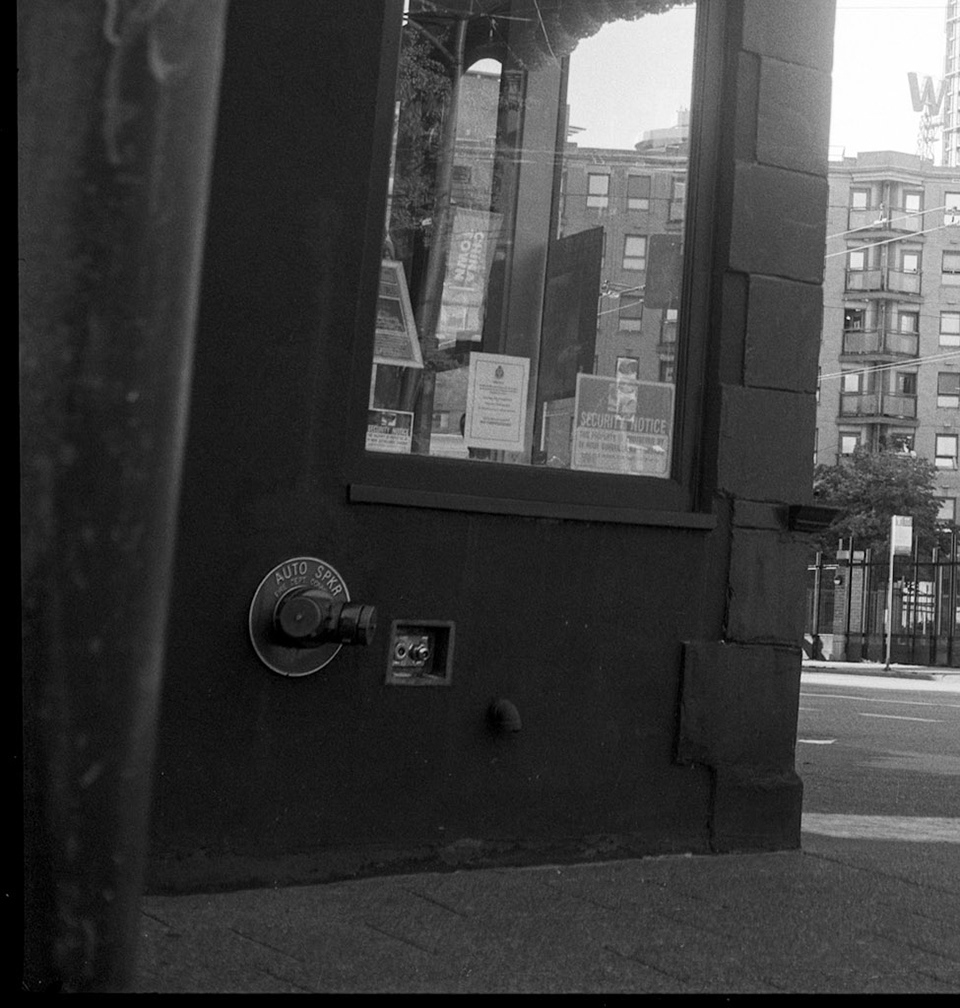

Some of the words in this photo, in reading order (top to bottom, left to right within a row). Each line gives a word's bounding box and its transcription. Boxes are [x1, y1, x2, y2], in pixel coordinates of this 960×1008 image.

[907, 71, 947, 116] W
[630, 417, 667, 434] NOTICE
[275, 561, 308, 585] AUTO
[315, 565, 343, 597] SPKR
